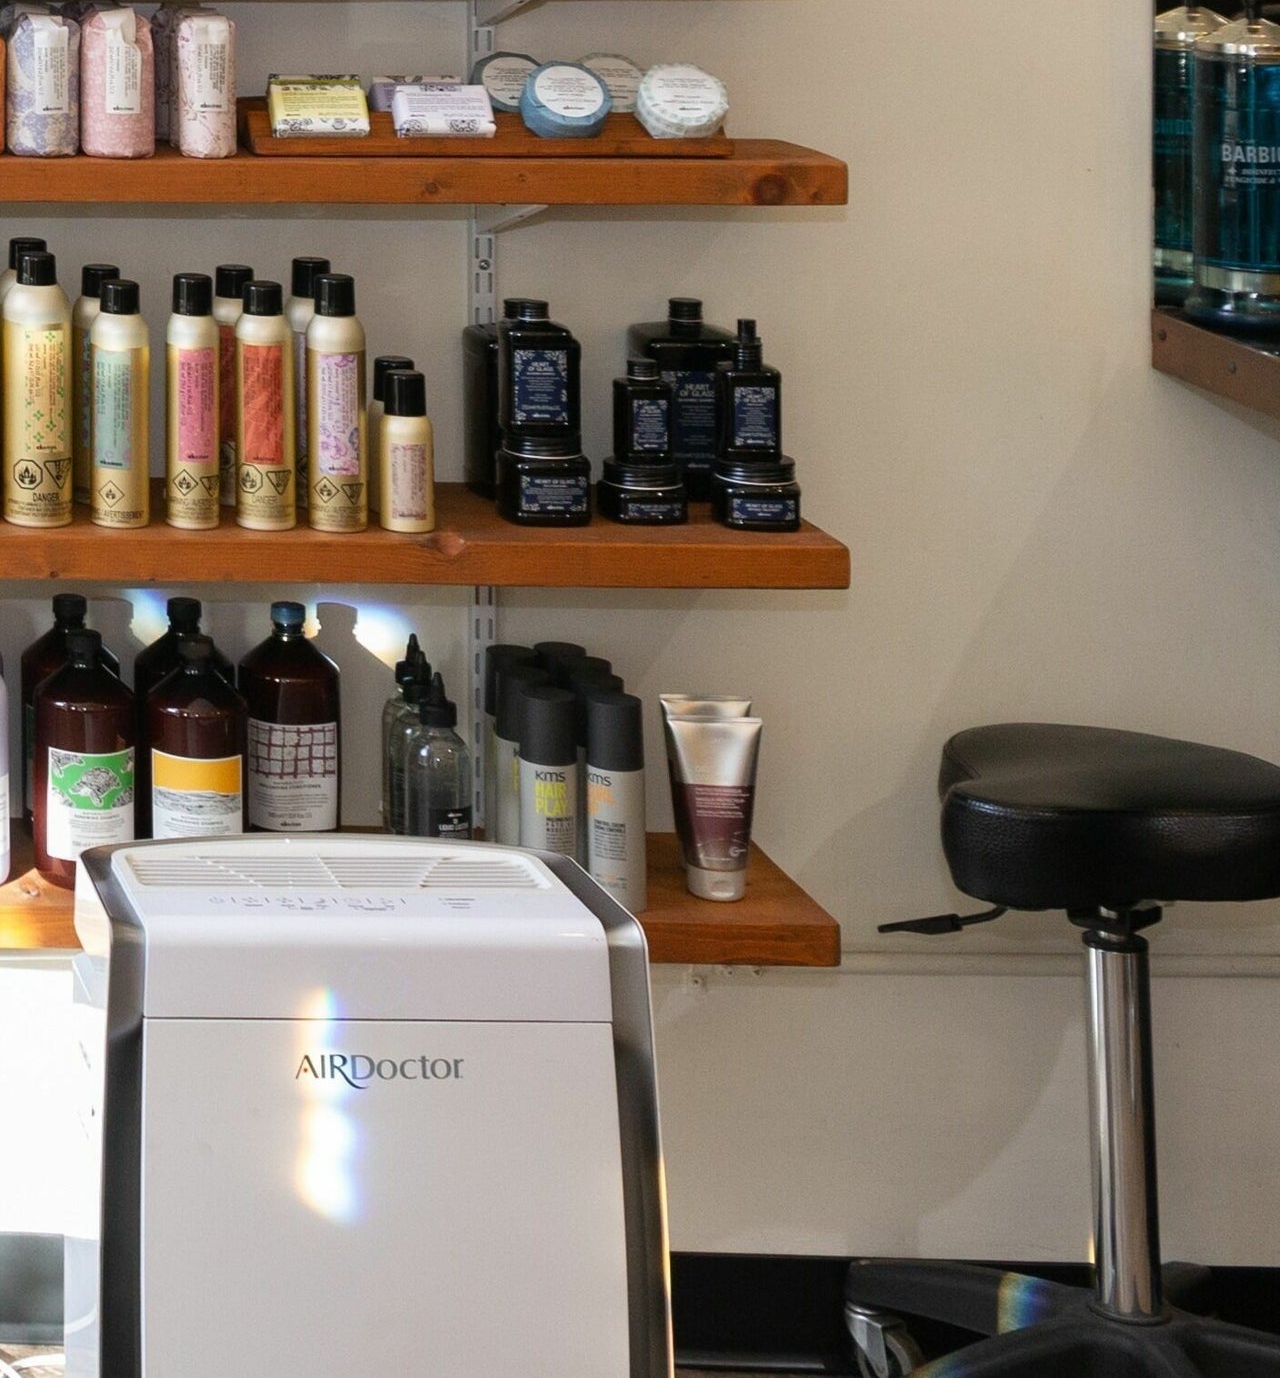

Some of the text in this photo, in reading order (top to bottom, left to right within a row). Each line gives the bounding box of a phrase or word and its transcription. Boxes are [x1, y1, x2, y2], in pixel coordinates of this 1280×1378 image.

[1222, 143, 1280, 163] BARBI
[32, 492, 60, 502] DANGER
[535, 771, 566, 782] kms
[535, 782, 566, 798] HAIR
[535, 798, 567, 816] PLAY
[296, 1054, 464, 1090] AIRDoctor
